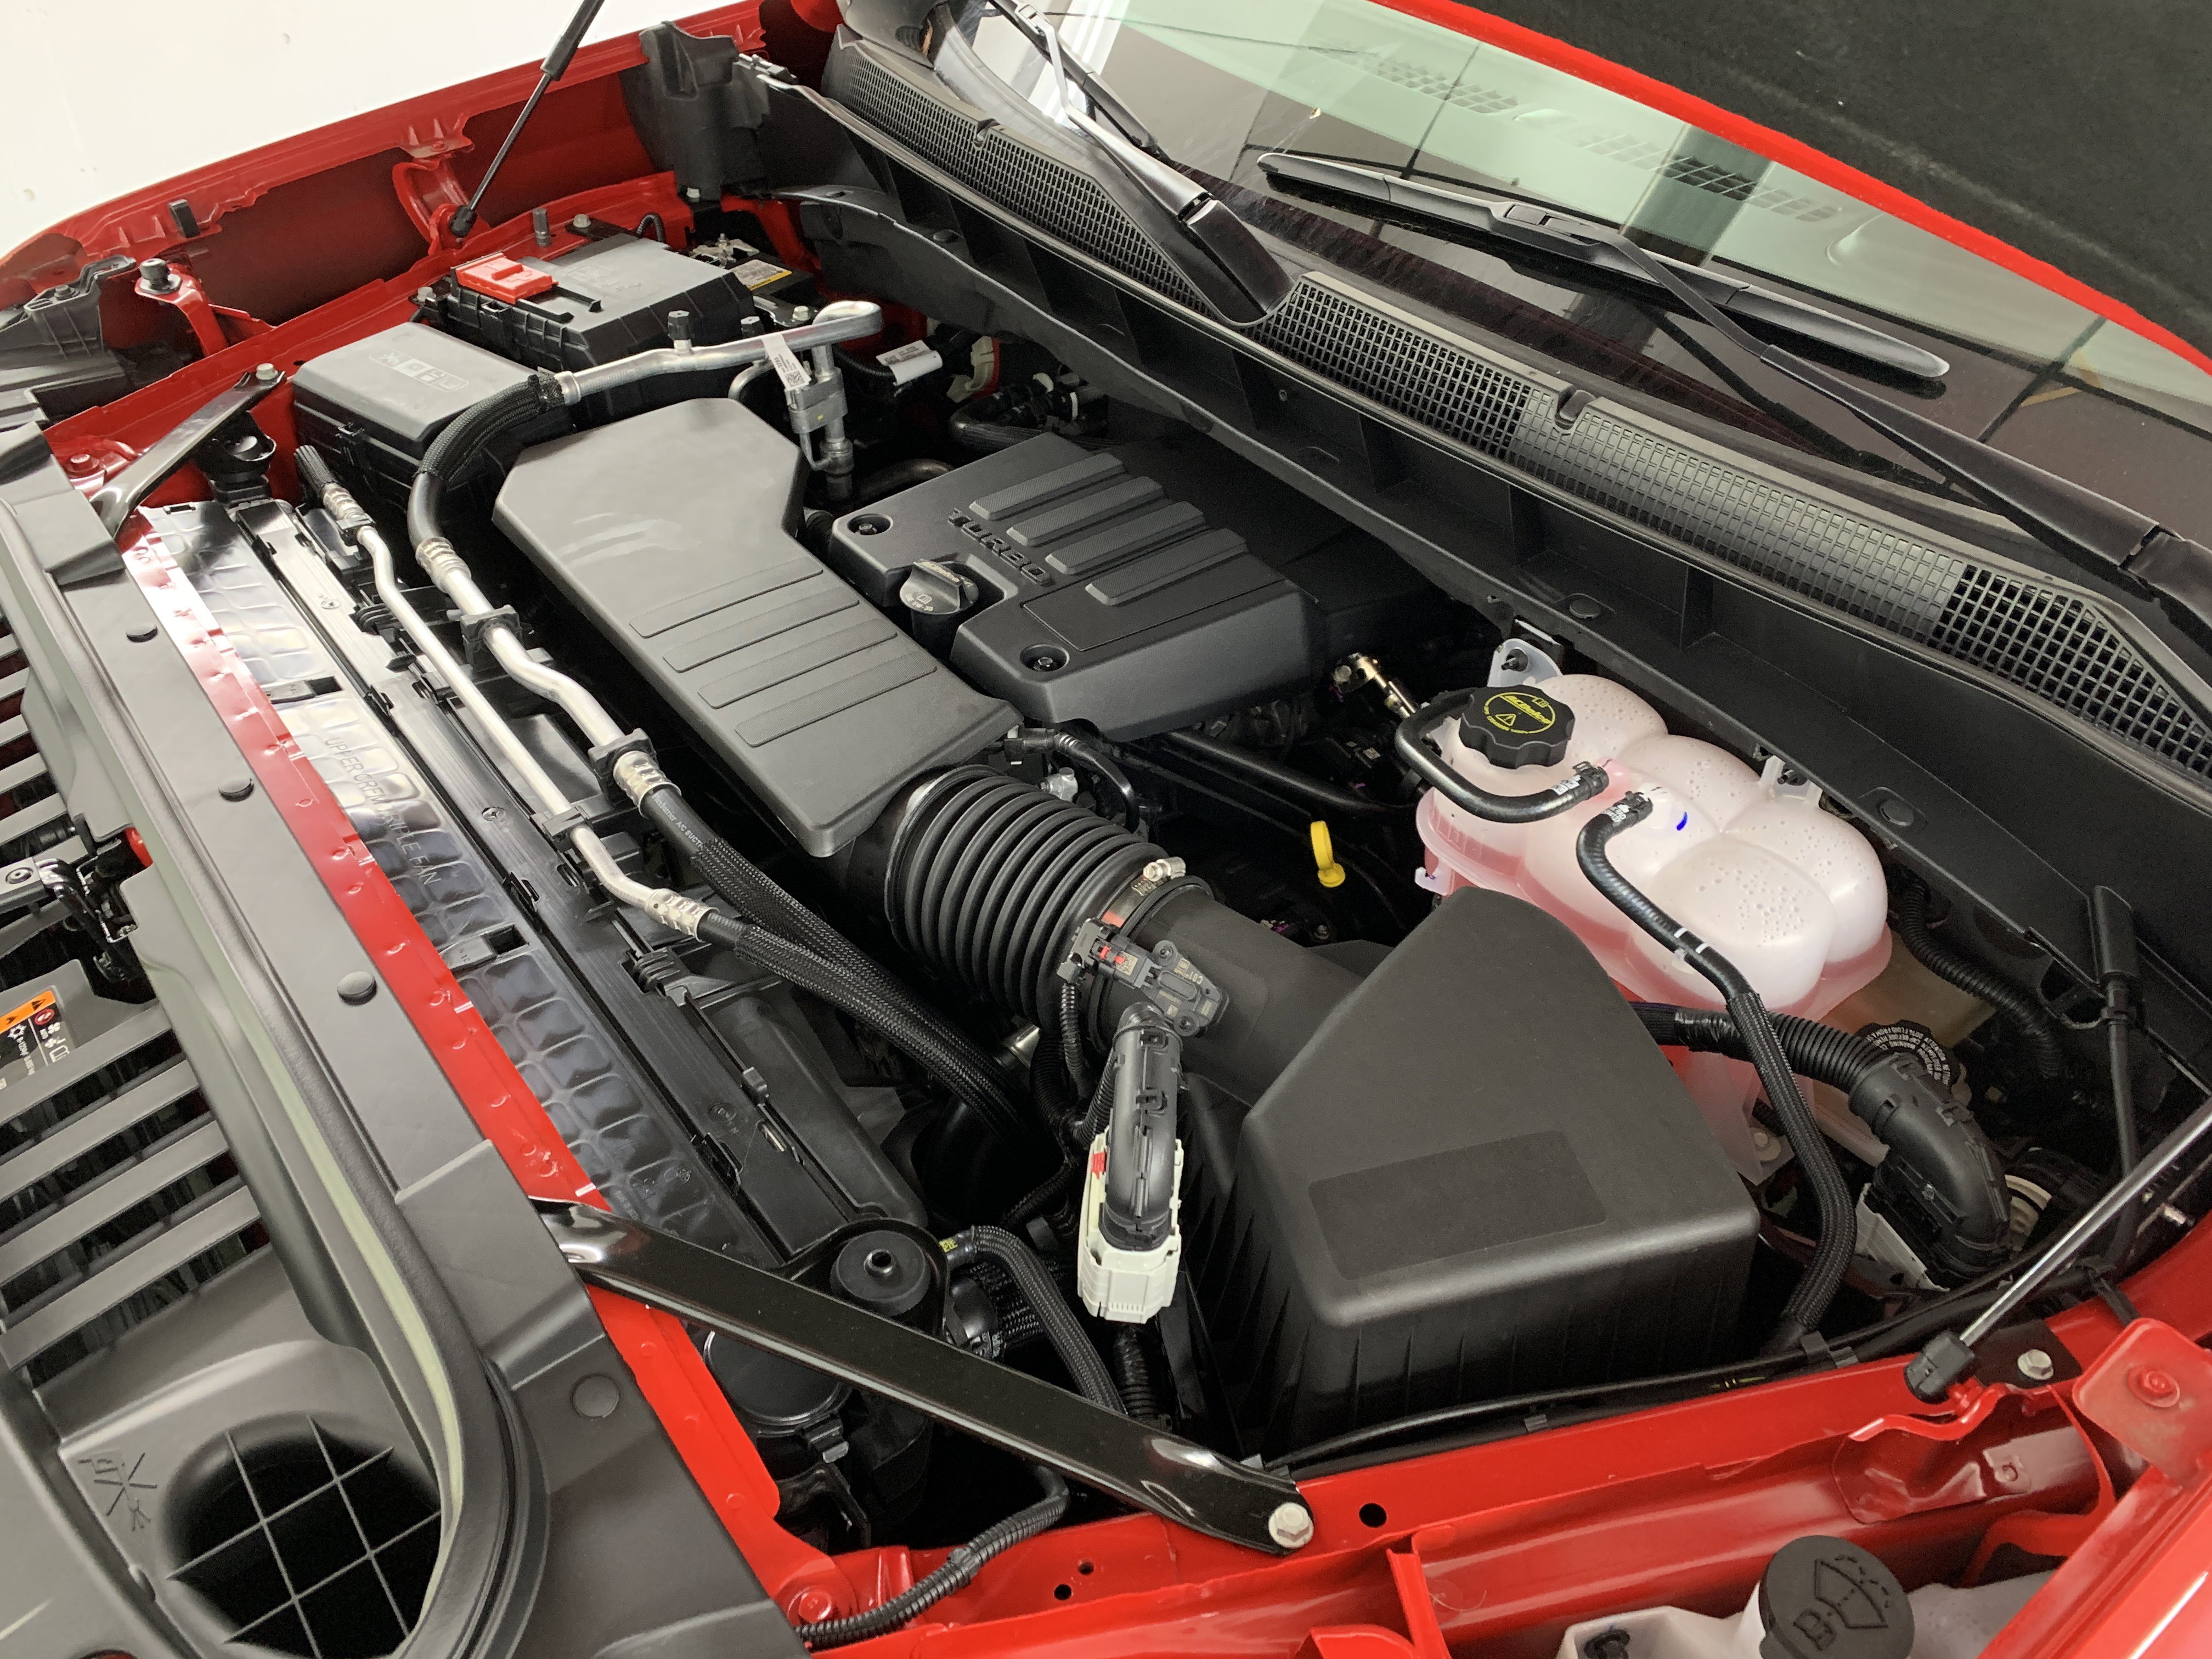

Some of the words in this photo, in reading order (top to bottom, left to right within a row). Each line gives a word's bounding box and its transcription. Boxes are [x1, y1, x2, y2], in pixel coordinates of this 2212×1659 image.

[948, 507, 1051, 585] TURBO
[912, 601, 934, 612] 5W-30
[1504, 695, 1552, 724] ACDelco
[325, 736, 364, 774] UPPER
[353, 772, 390, 806] CRFM
[379, 805, 421, 854] TRIPLE
[409, 854, 441, 885] FAN
[675, 820, 687, 831] A/C
[685, 830, 703, 850] SUCTI
